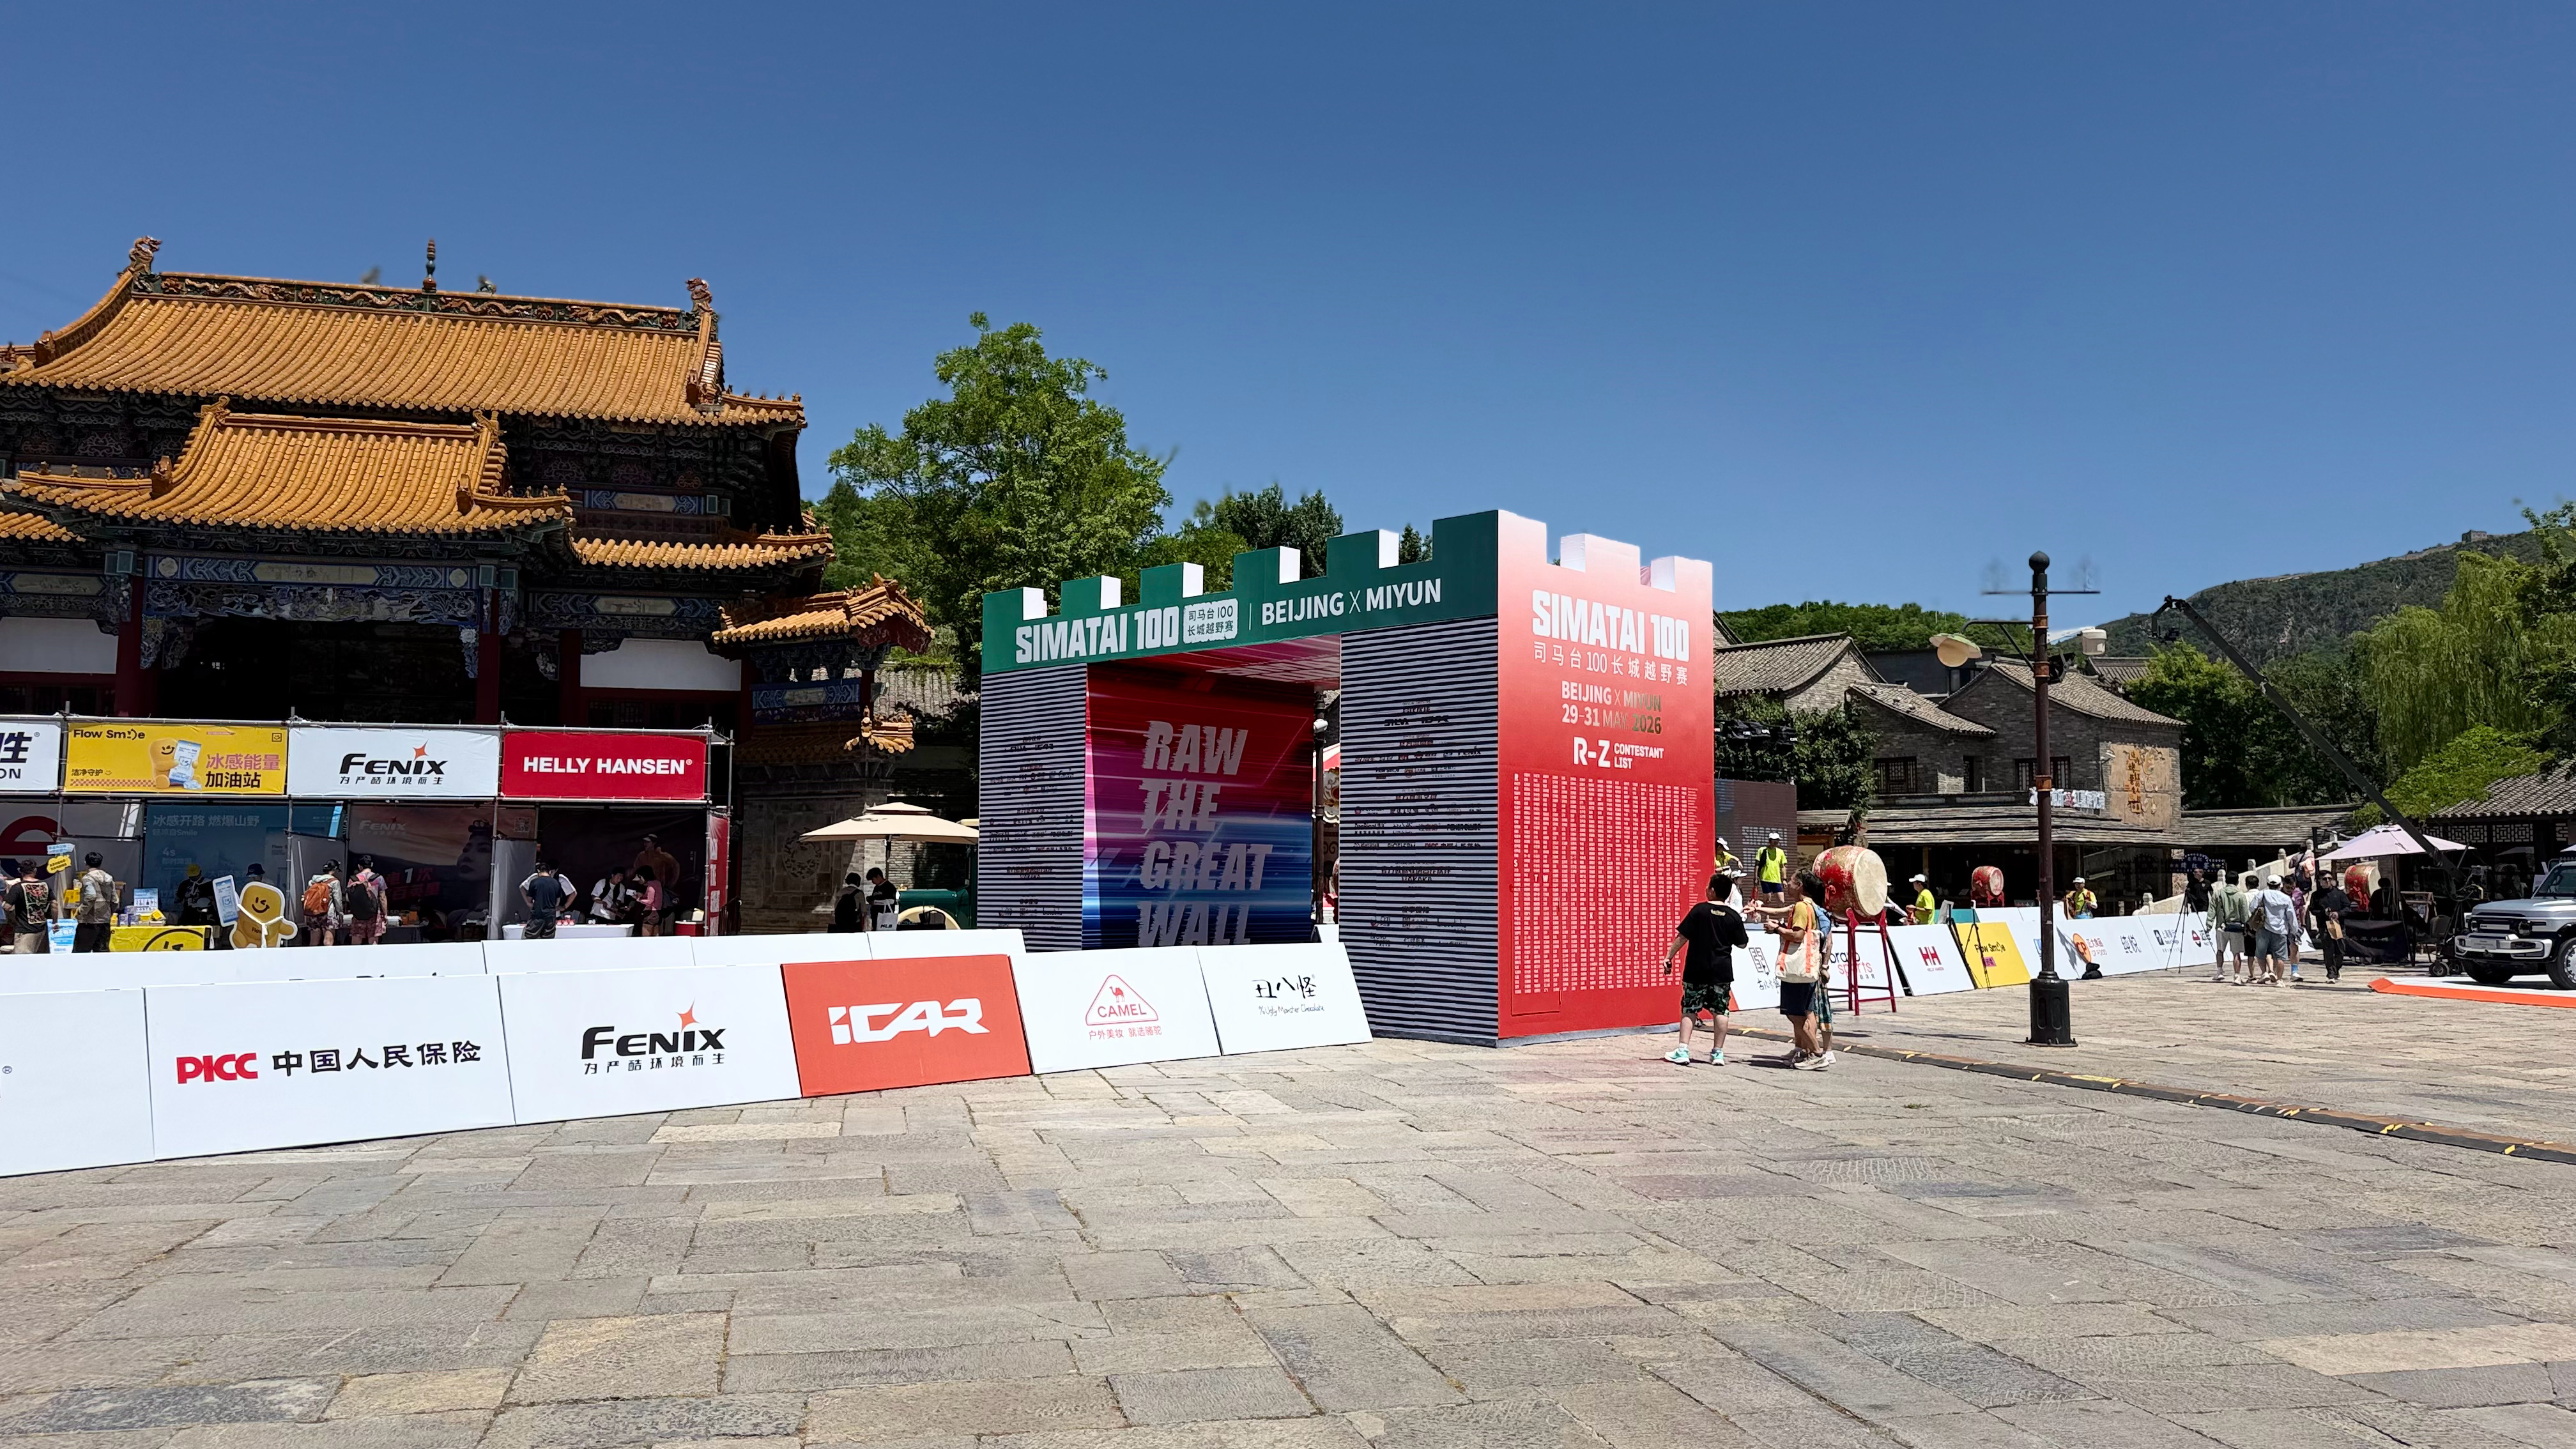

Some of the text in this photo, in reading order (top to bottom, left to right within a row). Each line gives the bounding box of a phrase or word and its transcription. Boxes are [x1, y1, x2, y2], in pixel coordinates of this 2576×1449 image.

[1262, 592, 1344, 625] BEIJING
[1365, 578, 1441, 612] MIYUN
[1016, 606, 1180, 664] SIMATAI 100
[1188, 620, 1234, 636] 长城越野赛
[1532, 589, 1689, 662] SIMATAI 100
[1561, 680, 1611, 705] BEIJING
[1623, 691, 1661, 712] MIYUN
[73, 729, 103, 739] Flow
[1561, 703, 1600, 727] 29-31
[1632, 713, 1662, 735] 2026
[206, 753, 281, 771] 冰感能量
[1141, 720, 1248, 776] RAW
[1573, 737, 1611, 768] R-Z
[1614, 742, 1664, 759] CONTESTANT
[1614, 756, 1633, 769] LIST
[205, 771, 261, 788] 加油站
[340, 753, 448, 775] FENIX
[523, 756, 685, 775] HELLY HANSEN
[1138, 778, 1222, 831] THE
[1138, 841, 1273, 891] GREAT
[1136, 900, 1252, 947] WALL
[1252, 975, 1317, 999] 丑八怪
[1098, 1004, 1147, 1018] CAMEL
[581, 1025, 727, 1060] FENIX
[176, 1040, 482, 1084] PICC 中国人民保险
[584, 1053, 726, 1075] 为严酷环境而生
